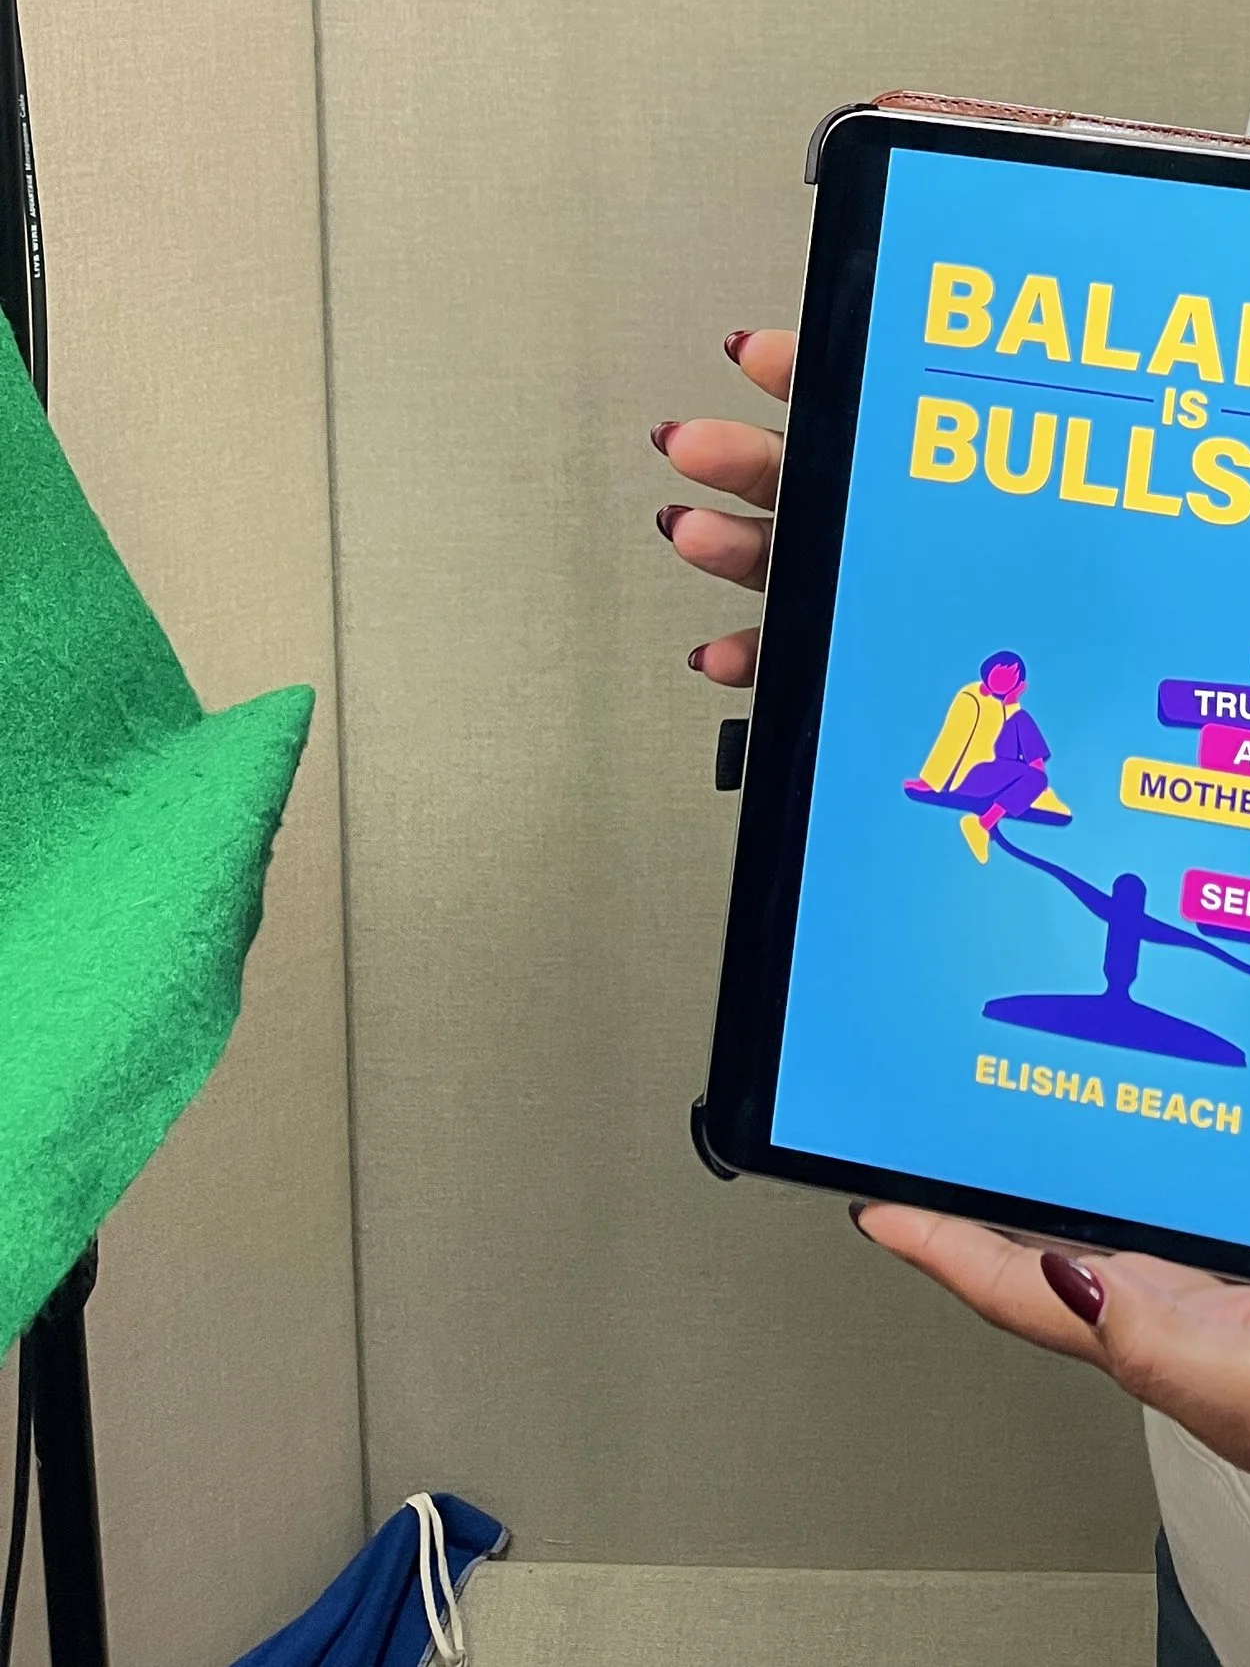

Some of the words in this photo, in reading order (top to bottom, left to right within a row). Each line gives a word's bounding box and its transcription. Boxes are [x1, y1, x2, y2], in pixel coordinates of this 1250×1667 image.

[1161, 387, 1209, 429] IS
[975, 1054, 1104, 1108] ELISHA
[1116, 1083, 1243, 1135] BEACH
